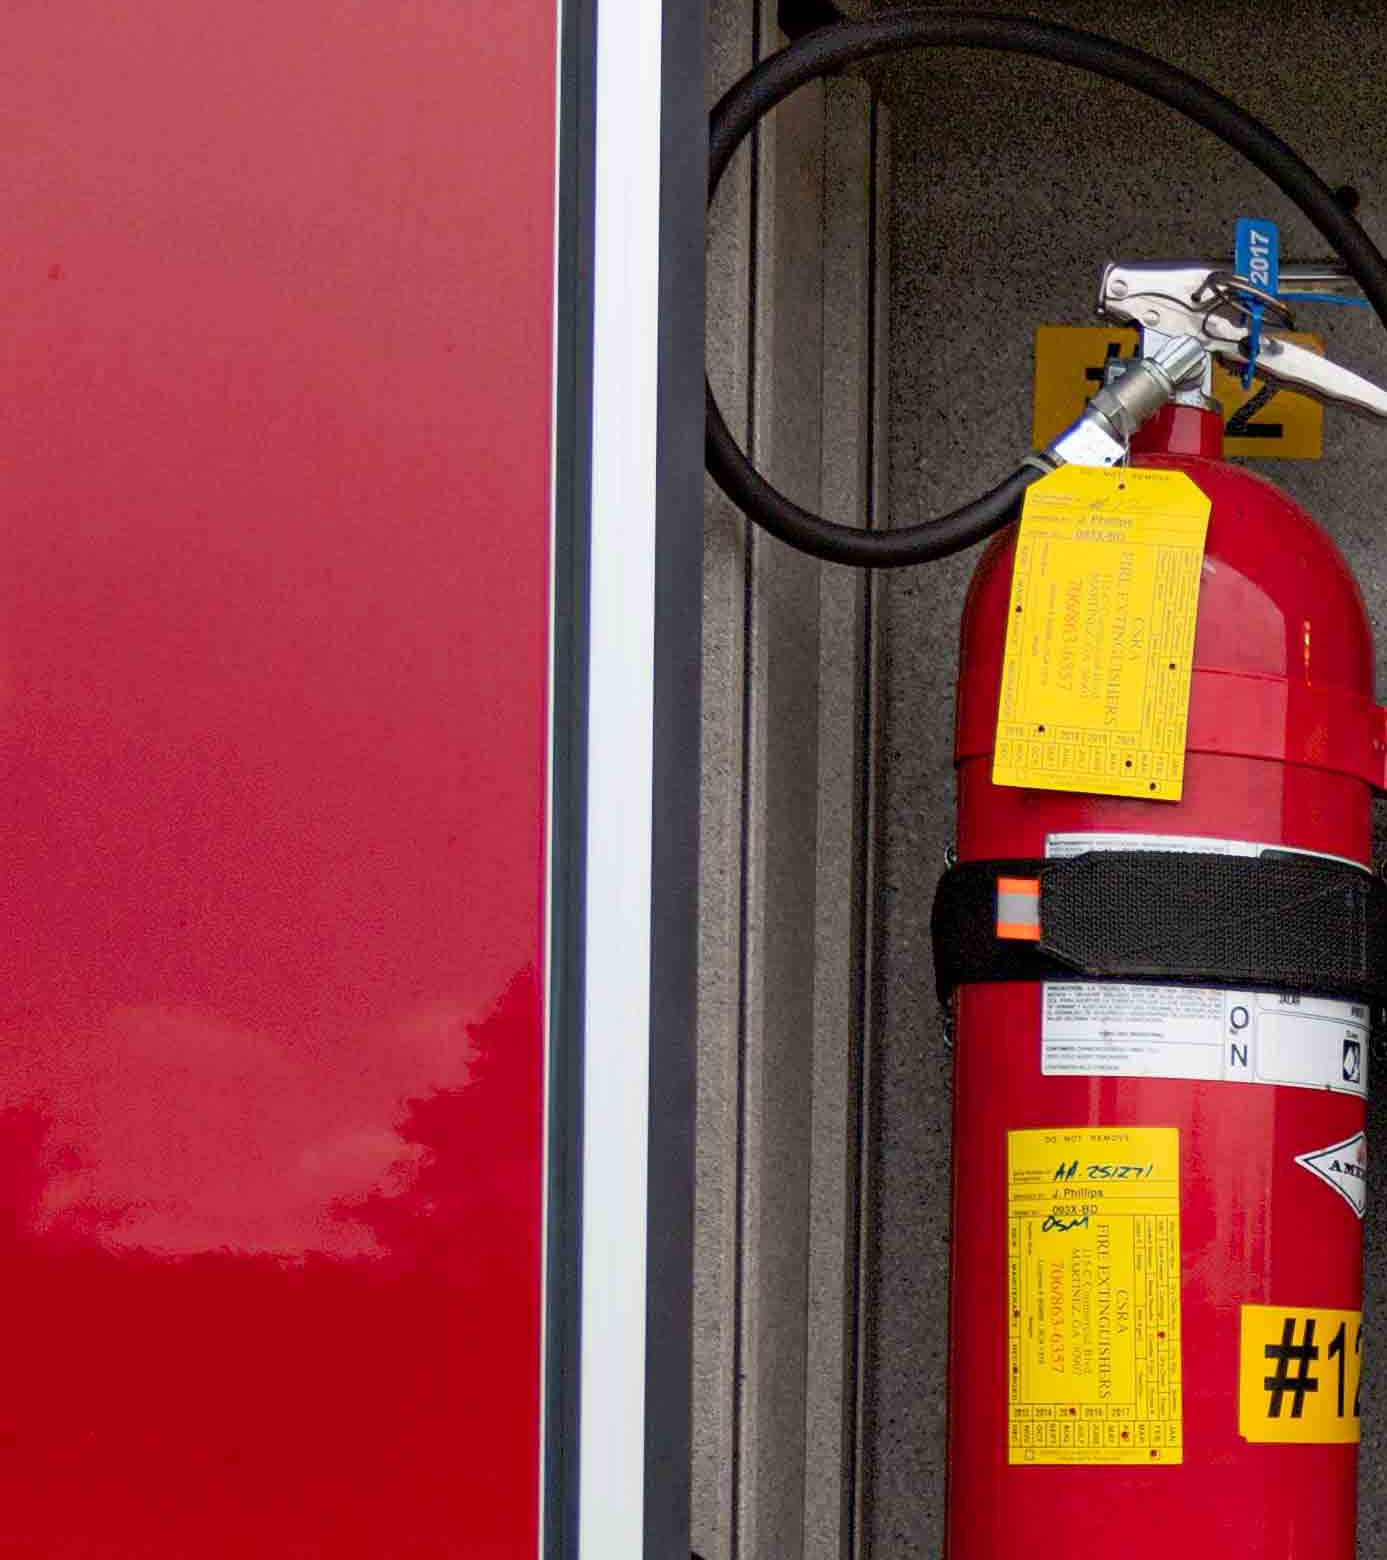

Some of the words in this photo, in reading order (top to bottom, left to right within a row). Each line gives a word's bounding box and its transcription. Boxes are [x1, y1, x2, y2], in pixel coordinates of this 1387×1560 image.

[1250, 230, 1270, 286] 2017
[1097, 1224, 1110, 1258] FIRE
[1097, 1265, 1112, 1400] EXTINGUISHERS
[1116, 1289, 1129, 1334] CSRA
[1264, 1317, 1362, 1419] #1
